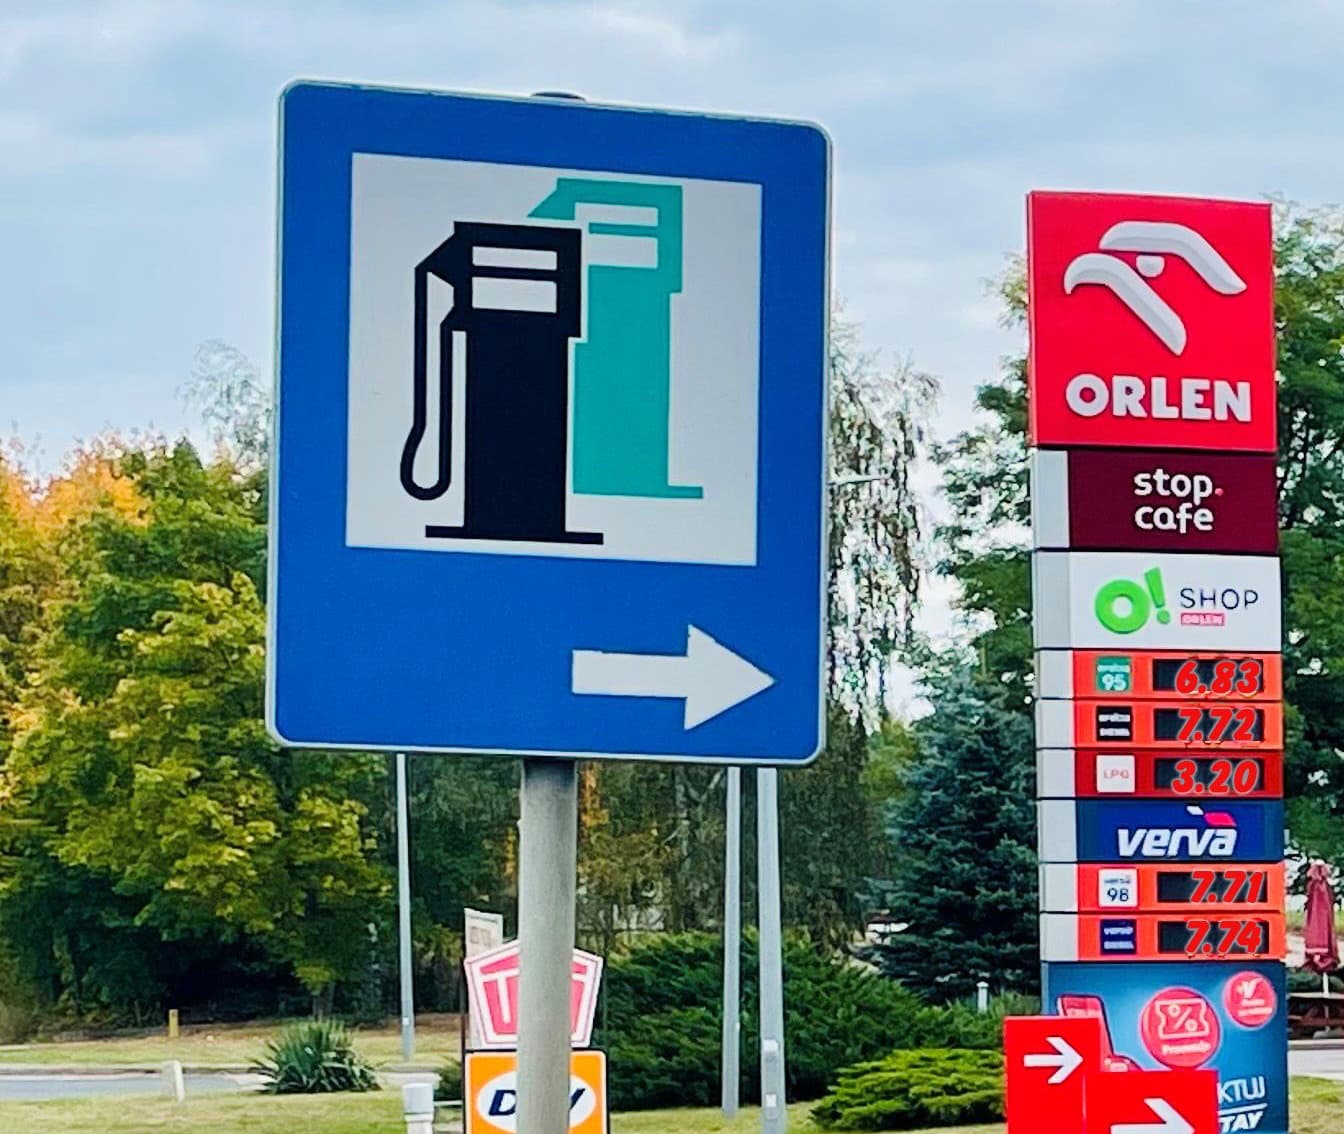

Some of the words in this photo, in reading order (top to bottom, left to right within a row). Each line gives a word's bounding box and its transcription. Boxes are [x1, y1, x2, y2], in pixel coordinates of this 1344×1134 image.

[1065, 373, 1253, 423] ORLEN
[1134, 503, 1215, 534] cafe
[1094, 566, 1171, 635] O!
[1180, 587, 1259, 610] SHOP
[1101, 674, 1127, 692] 95
[1175, 661, 1260, 695] 6.83
[1178, 708, 1256, 742] 7.72
[1171, 760, 1258, 794] 3.20
[1117, 827, 1238, 857] verva
[1106, 887, 1129, 902] 98
[1189, 870, 1265, 903] 7.71
[1184, 919, 1262, 954] 7.74
